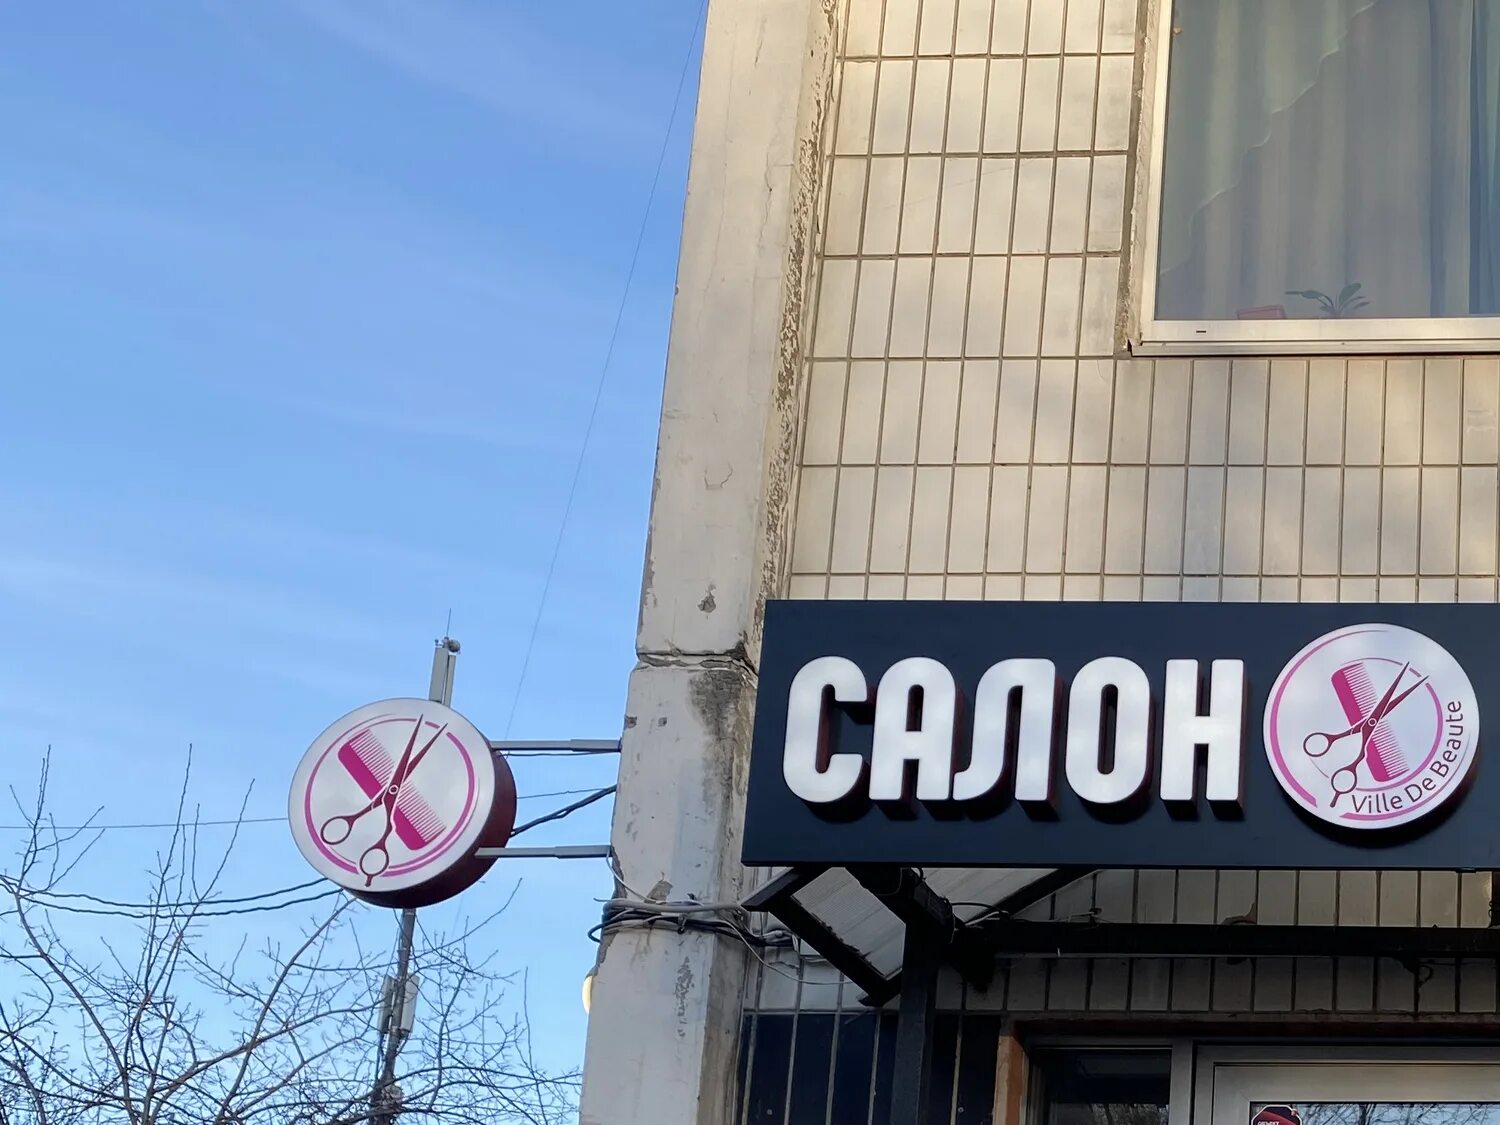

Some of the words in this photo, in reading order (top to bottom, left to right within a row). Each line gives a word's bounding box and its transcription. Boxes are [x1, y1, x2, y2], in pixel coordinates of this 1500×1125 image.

[783, 655, 1245, 804] САЛОН
[1351, 794, 1403, 814] Ville
[1404, 777, 1437, 803] De
[1430, 700, 1464, 778] Beaute
